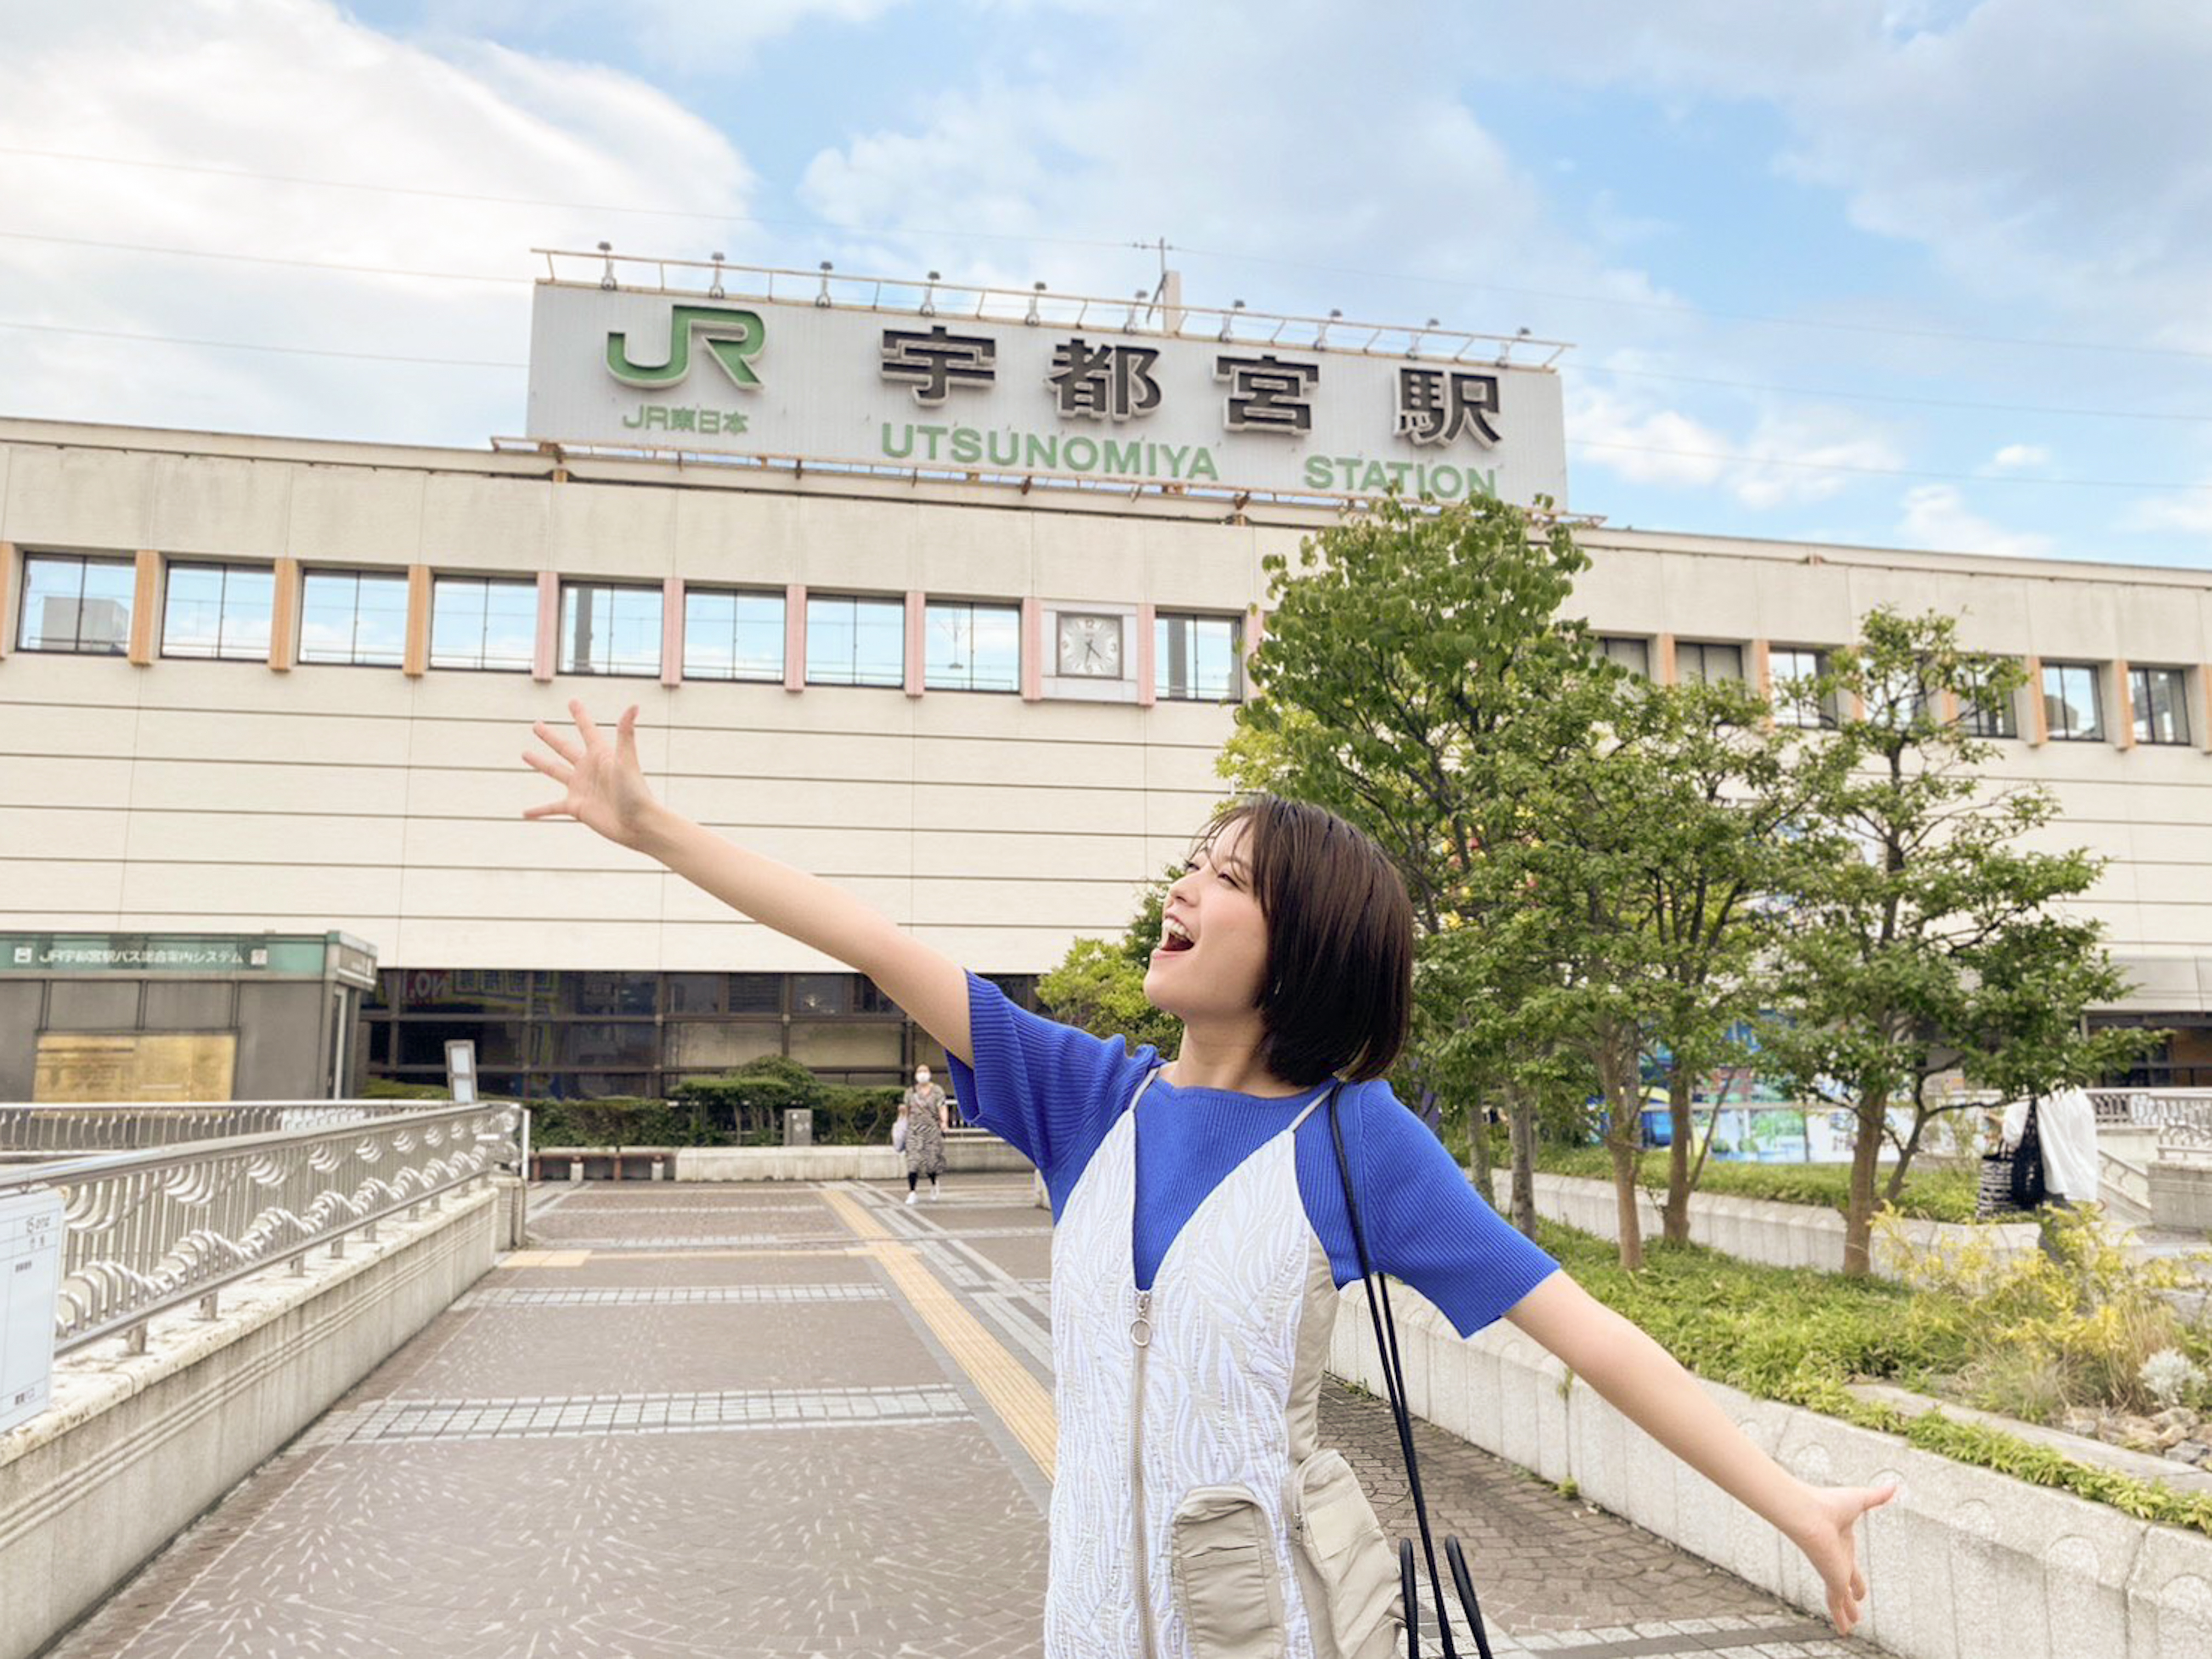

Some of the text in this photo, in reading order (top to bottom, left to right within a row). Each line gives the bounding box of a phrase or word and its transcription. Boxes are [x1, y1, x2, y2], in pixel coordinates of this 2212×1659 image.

[607, 305, 765, 388] JR
[622, 404, 748, 435] JR東日本
[881, 325, 1502, 450] 宇都宮駅
[882, 421, 1497, 499] UTSUNOMIYA STATION
